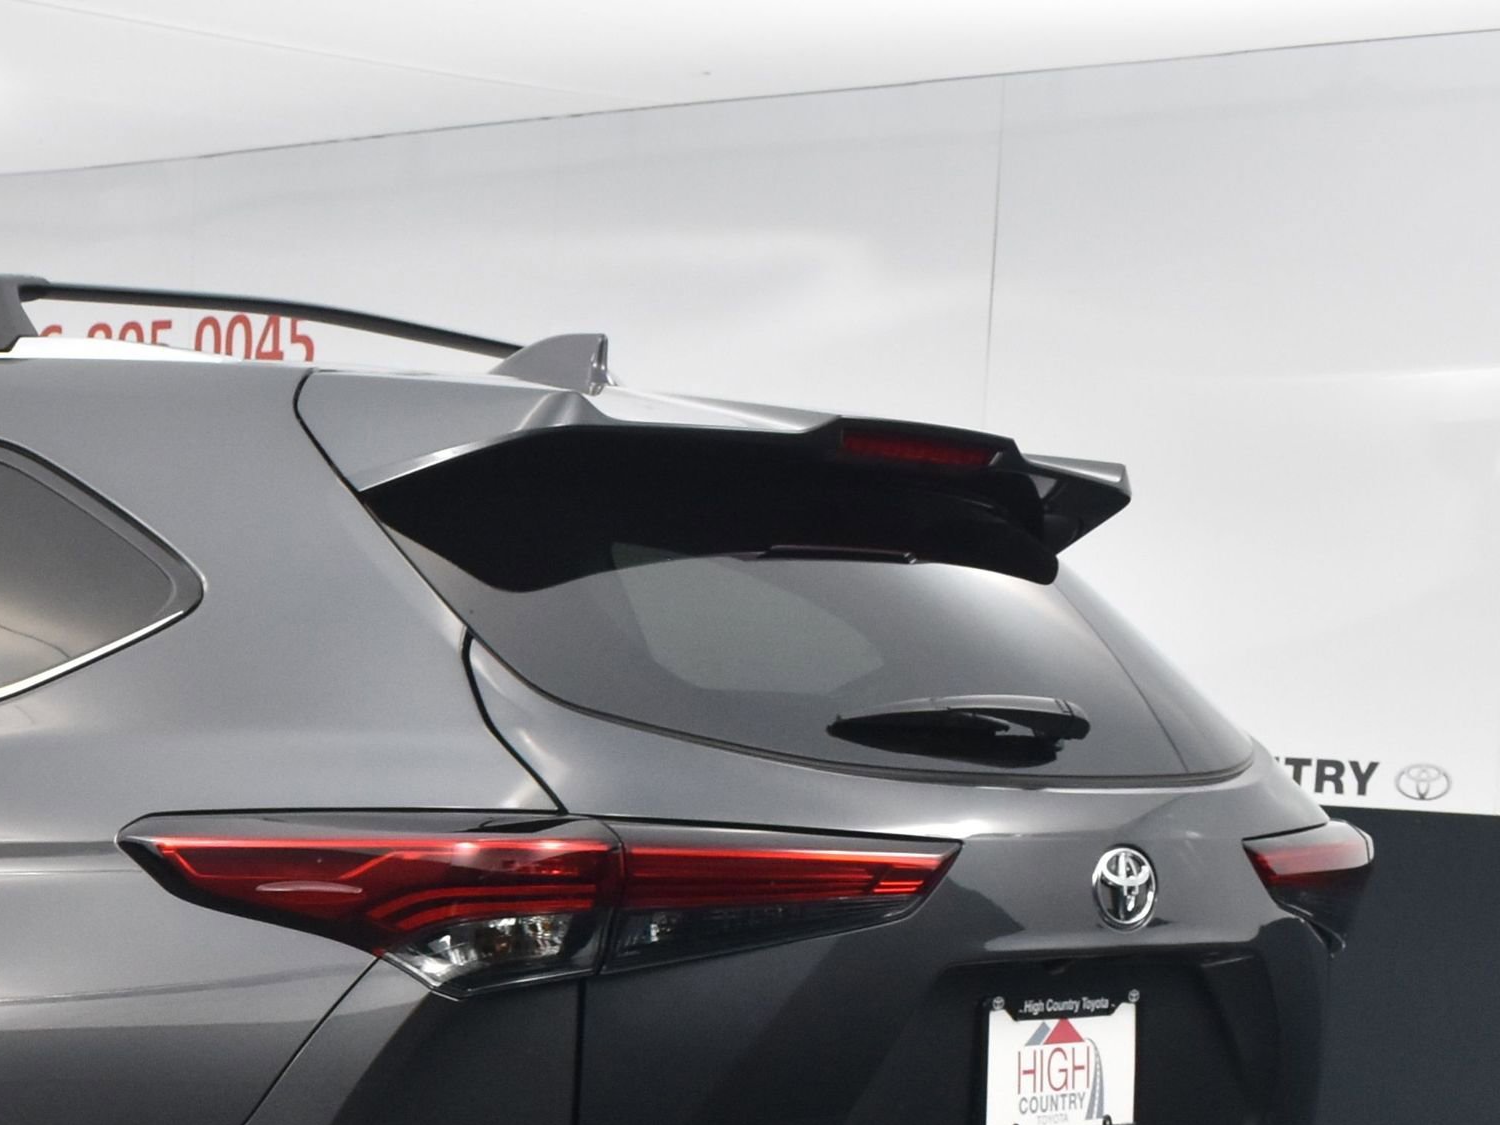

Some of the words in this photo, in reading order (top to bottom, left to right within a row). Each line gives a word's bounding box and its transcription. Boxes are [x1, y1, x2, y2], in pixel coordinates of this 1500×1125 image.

[1274, 756, 1380, 796] TRY
[1023, 1000, 1045, 1016] High
[1045, 998, 1080, 1014] Country
[1081, 996, 1109, 1013] Toyota
[1017, 1046, 1091, 1095] HIGH
[1018, 1091, 1087, 1115] COUNTRY
